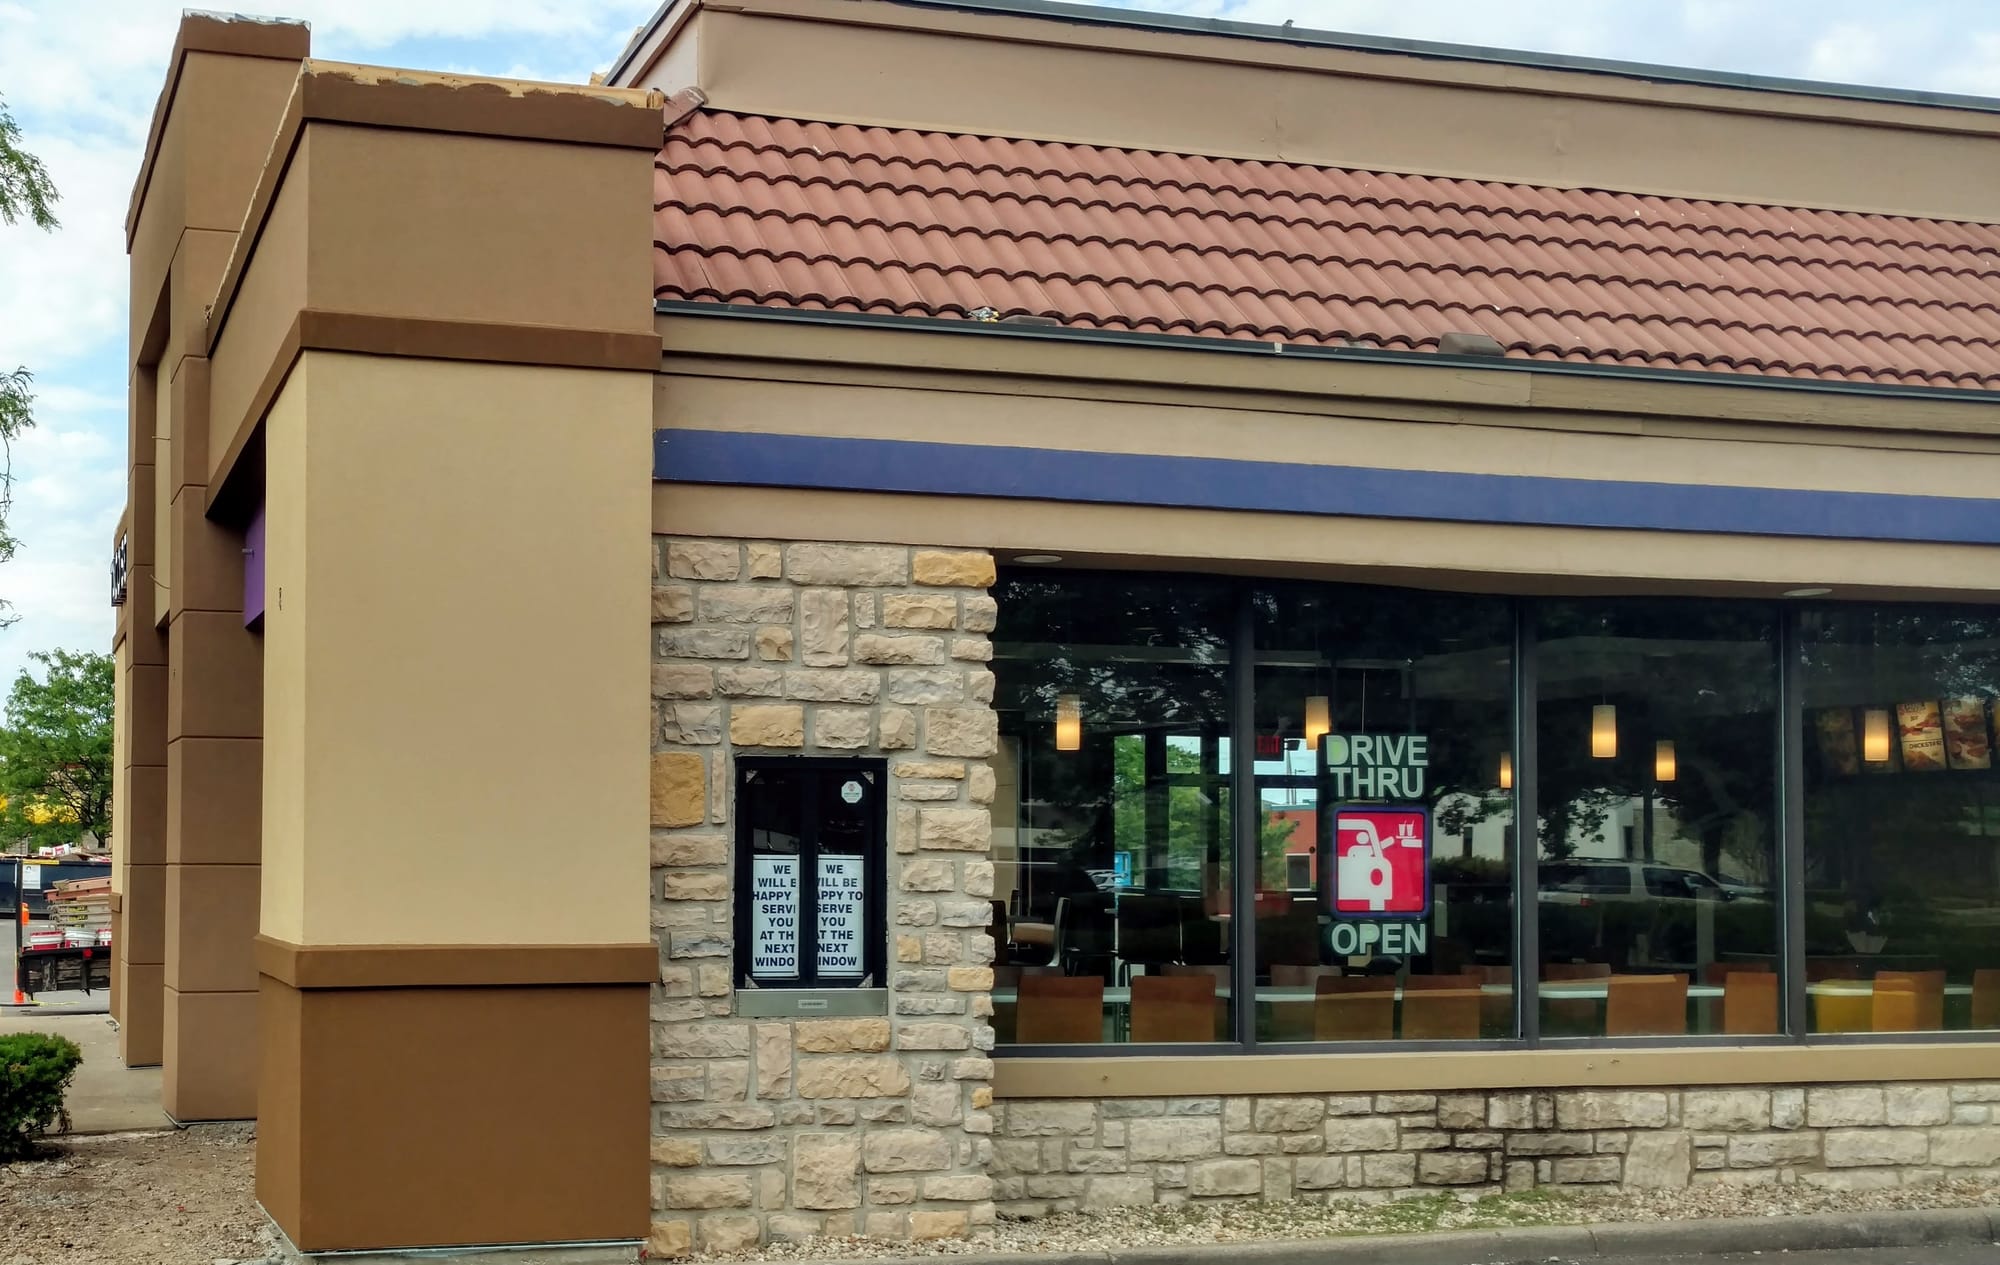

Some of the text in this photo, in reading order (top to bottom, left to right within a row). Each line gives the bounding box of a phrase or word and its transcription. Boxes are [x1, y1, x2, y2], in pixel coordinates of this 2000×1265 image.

[1326, 735, 1428, 766] DRIVE
[1330, 767, 1424, 798] THRU
[773, 865, 791, 874] WE
[826, 865, 843, 874] WE
[758, 878, 786, 887] WILL
[818, 878, 857, 887] ILL BE
[753, 891, 791, 901] HAPPY
[848, 891, 863, 901] TO
[762, 904, 795, 913] SERV
[769, 918, 793, 927] YOU
[821, 917, 845, 926] YOU
[760, 931, 794, 940] AT TH
[831, 930, 853, 939] THE
[1331, 923, 1426, 955] OPEN
[765, 944, 794, 953] NEXT
[817, 943, 848, 953] NEXT
[755, 957, 794, 966] WINDO
[818, 957, 857, 966] INDOW
